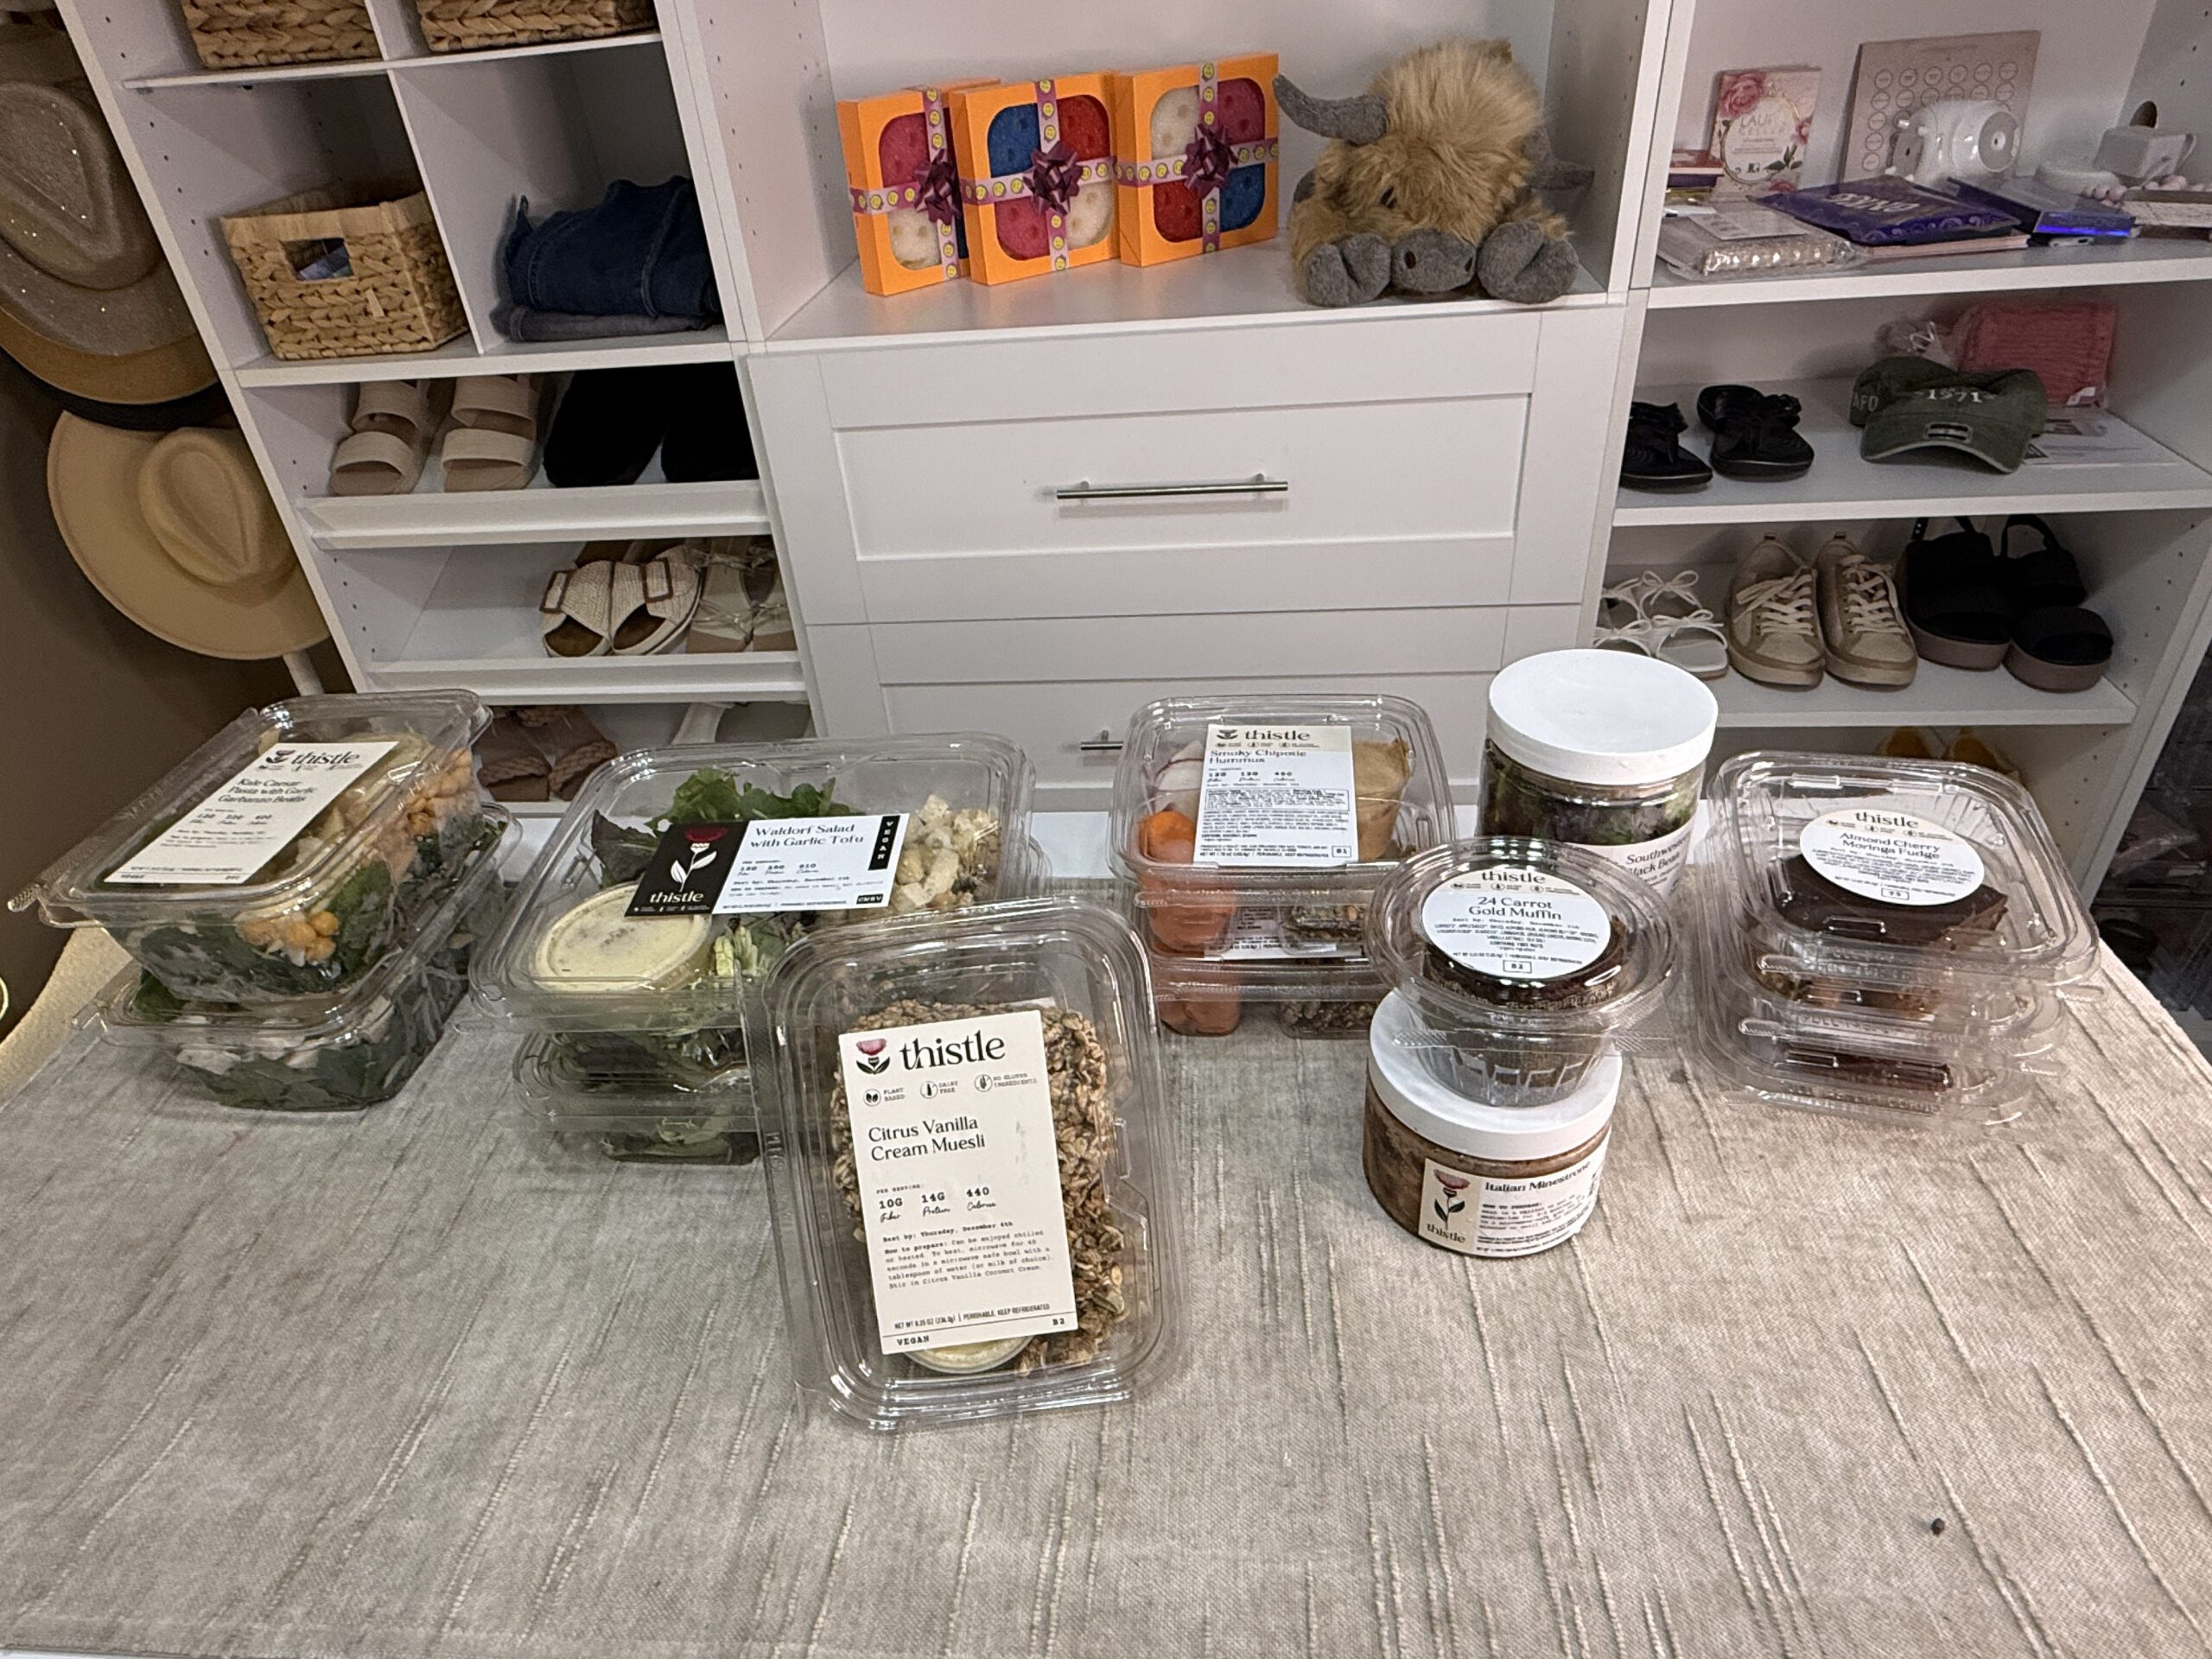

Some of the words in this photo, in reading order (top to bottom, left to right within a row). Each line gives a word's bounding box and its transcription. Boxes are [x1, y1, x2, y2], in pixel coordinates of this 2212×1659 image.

[1245, 730, 1310, 741] thistle
[291, 750, 361, 765] thistle
[1855, 811, 1919, 828] thistle
[756, 825, 814, 836] Waldorf
[817, 823, 855, 835] Salad
[750, 839, 780, 849] with
[784, 836, 827, 847] Garlic
[830, 835, 864, 845] Tofu
[876, 820, 893, 861] VEGAN
[1840, 832, 1891, 846] Almond
[1894, 839, 1941, 853] Cherry
[1842, 840, 1897, 855] Moringa
[1899, 847, 1940, 860] Fudge
[1481, 871, 1547, 884] thistle
[650, 891, 704, 903] thistle
[1478, 896, 1497, 906] 24
[1502, 897, 1553, 909] Carrot
[1469, 906, 1506, 917] Gold
[1510, 907, 1561, 920] Muffin
[899, 1030, 1006, 1071] thistle
[868, 1125, 919, 1142] Citrus
[922, 1116, 978, 1135] Vanilla
[871, 1143, 928, 1161] Cream
[931, 1134, 986, 1154] Muesli
[1484, 1181, 1526, 1192] Italian
[880, 1198, 903, 1210] 10G
[921, 1192, 945, 1203] 14G
[966, 1186, 989, 1198] 440
[880, 1211, 900, 1223] Fiber
[923, 1206, 950, 1217] Protein
[967, 1200, 996, 1211] Calories
[981, 1233, 1010, 1242] enjoyed
[1426, 1222, 1466, 1243] thistle
[887, 1262, 916, 1272] seconds
[941, 1255, 979, 1264] microwave
[888, 1270, 931, 1281] tablespoon
[922, 1276, 948, 1285] Citrus
[951, 1272, 982, 1281] Vanilla
[997, 1307, 1011, 1316] KEEP
[1012, 1303, 1051, 1314] REFRIGERATED
[897, 1335, 930, 1346] VEGAN
